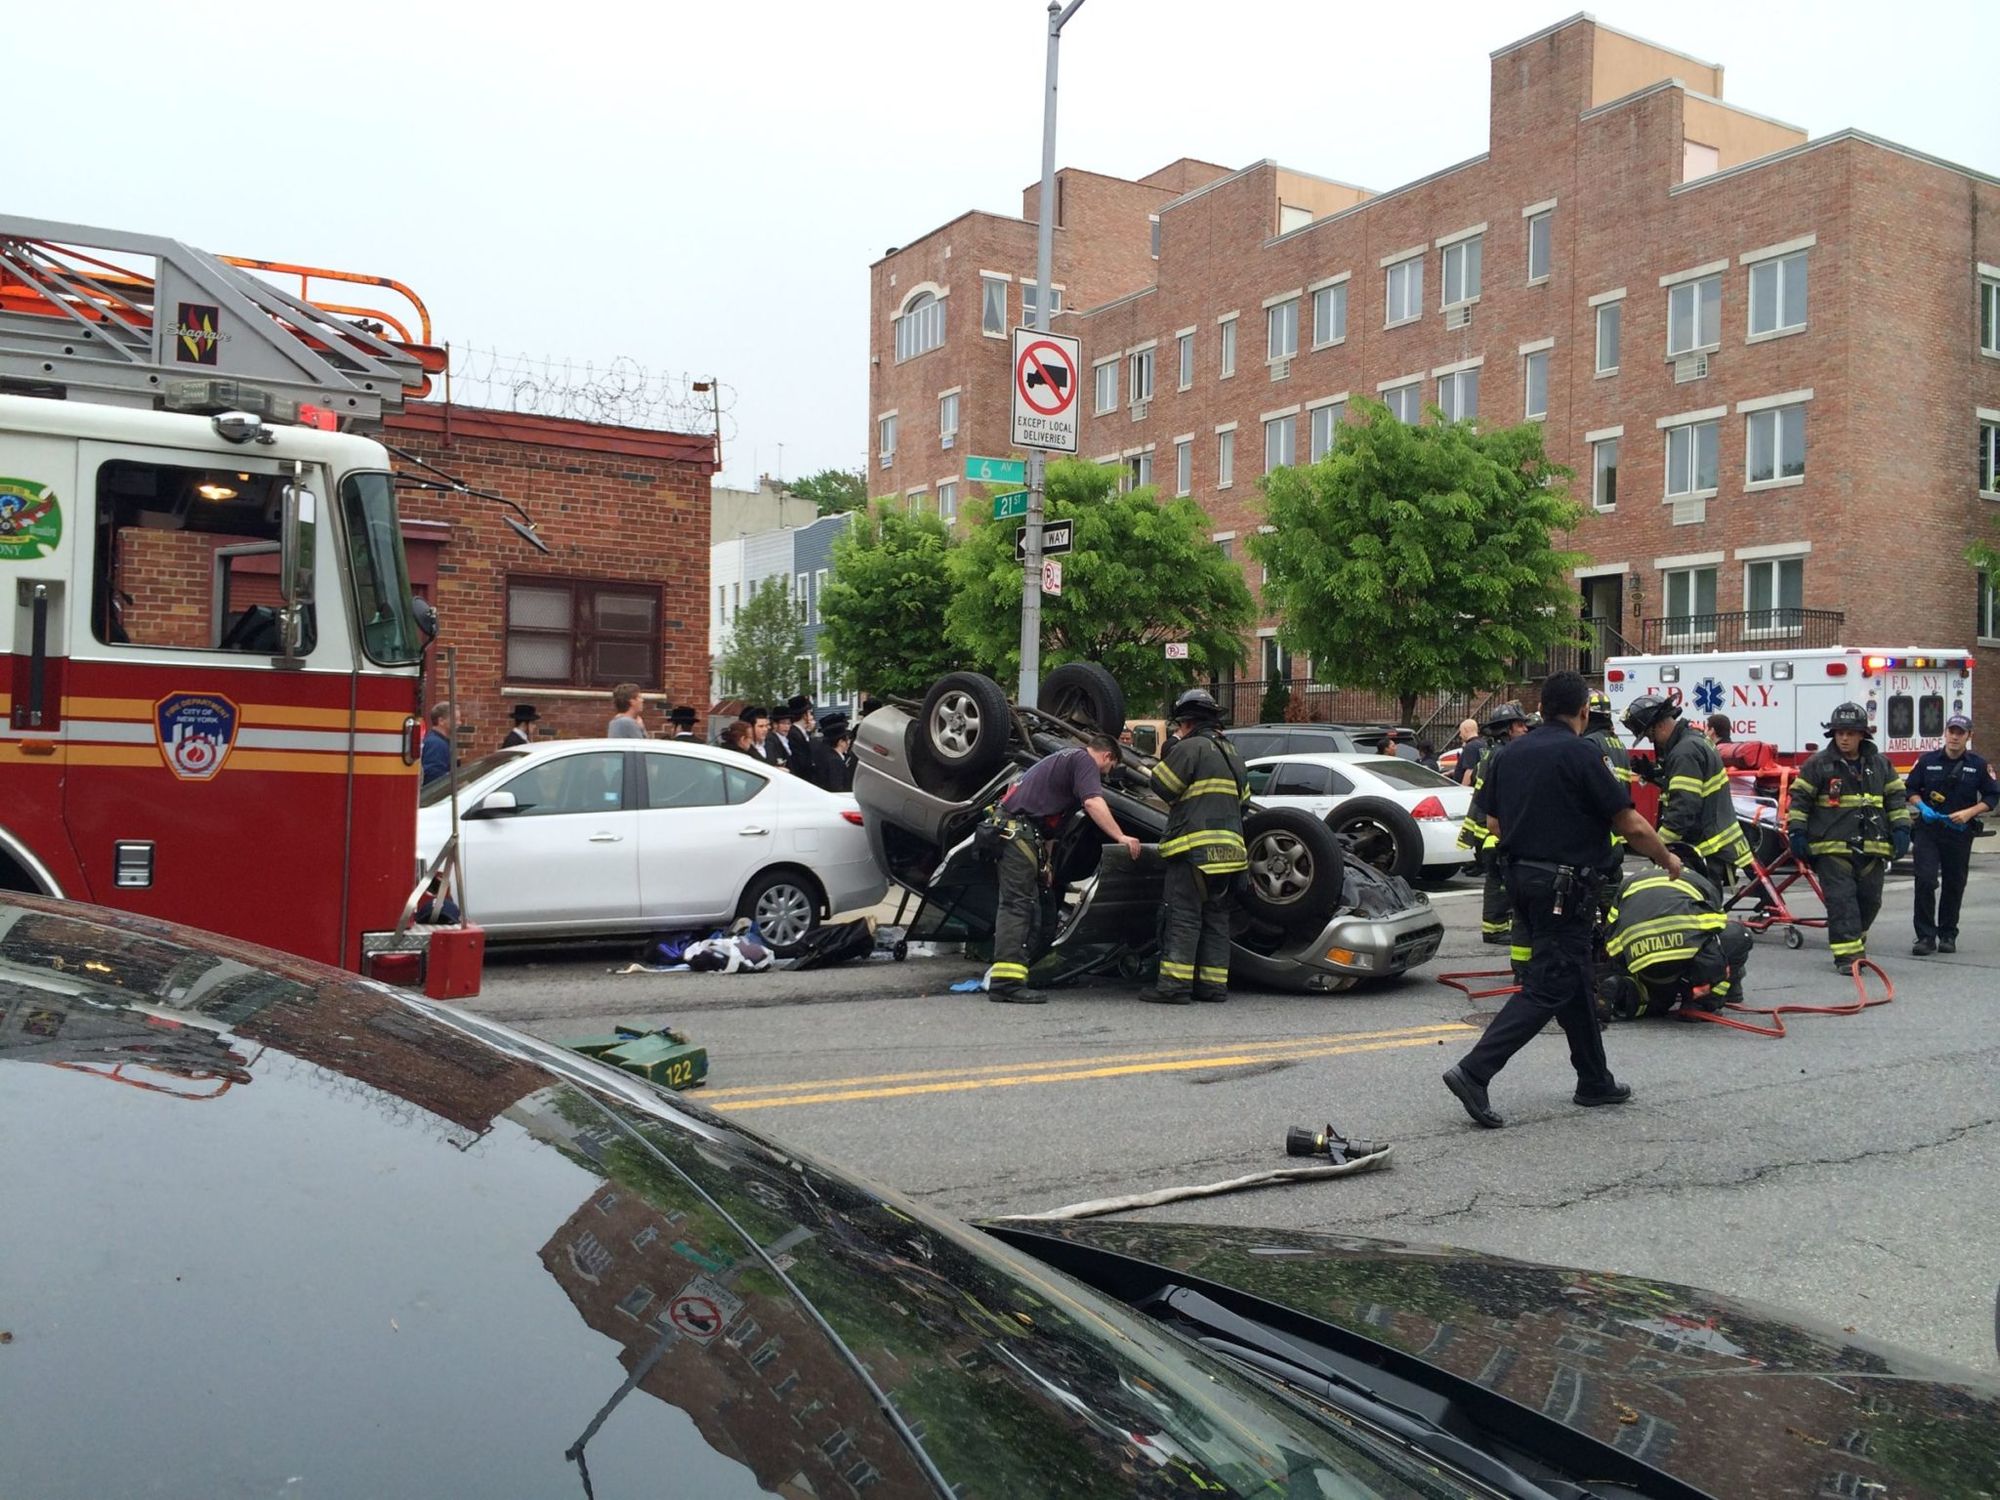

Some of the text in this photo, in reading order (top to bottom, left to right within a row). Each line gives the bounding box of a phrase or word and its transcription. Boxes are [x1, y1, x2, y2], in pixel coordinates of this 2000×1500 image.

[164, 321, 232, 343] Seagrave
[1017, 416, 1073, 433] EXCEPT LOCAL
[1023, 430, 1066, 445] DELIVERIES
[981, 460, 1013, 479] 6 AV
[1000, 494, 1021, 515] 21 ST
[1048, 531, 1066, 545] WAY
[1609, 683, 1624, 693] 086
[1892, 675, 1941, 690] F.D. N.Y.
[1731, 685, 1778, 708] N.Y.
[197, 716, 219, 724] YORK
[1888, 737, 1943, 751] AMBULANCE
[1630, 932, 1684, 958] MONTALVO
[666, 1060, 693, 1085] 122
